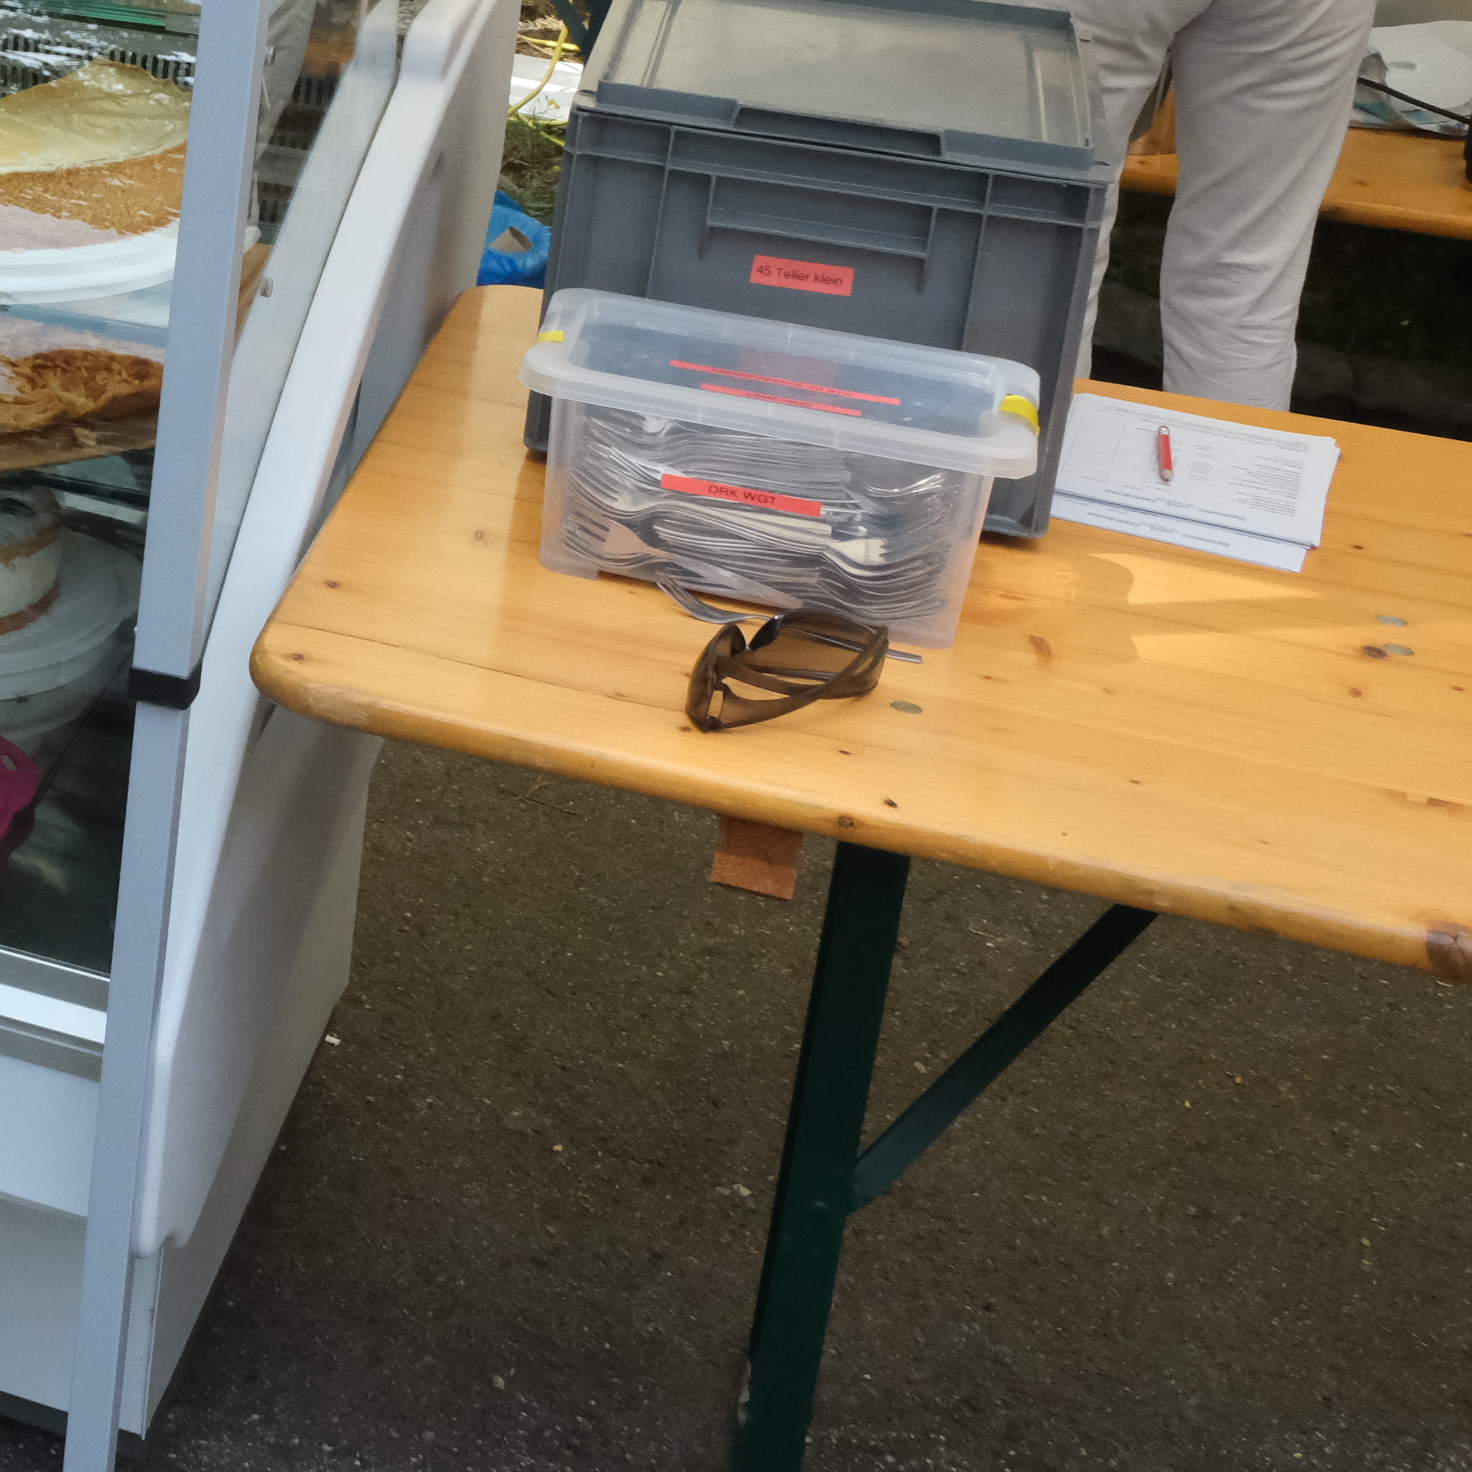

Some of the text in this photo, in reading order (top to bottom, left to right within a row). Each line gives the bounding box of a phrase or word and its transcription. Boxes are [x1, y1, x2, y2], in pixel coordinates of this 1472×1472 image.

[756, 265, 843, 287] 45 Teller klein
[708, 485, 776, 505] DRK WGT
